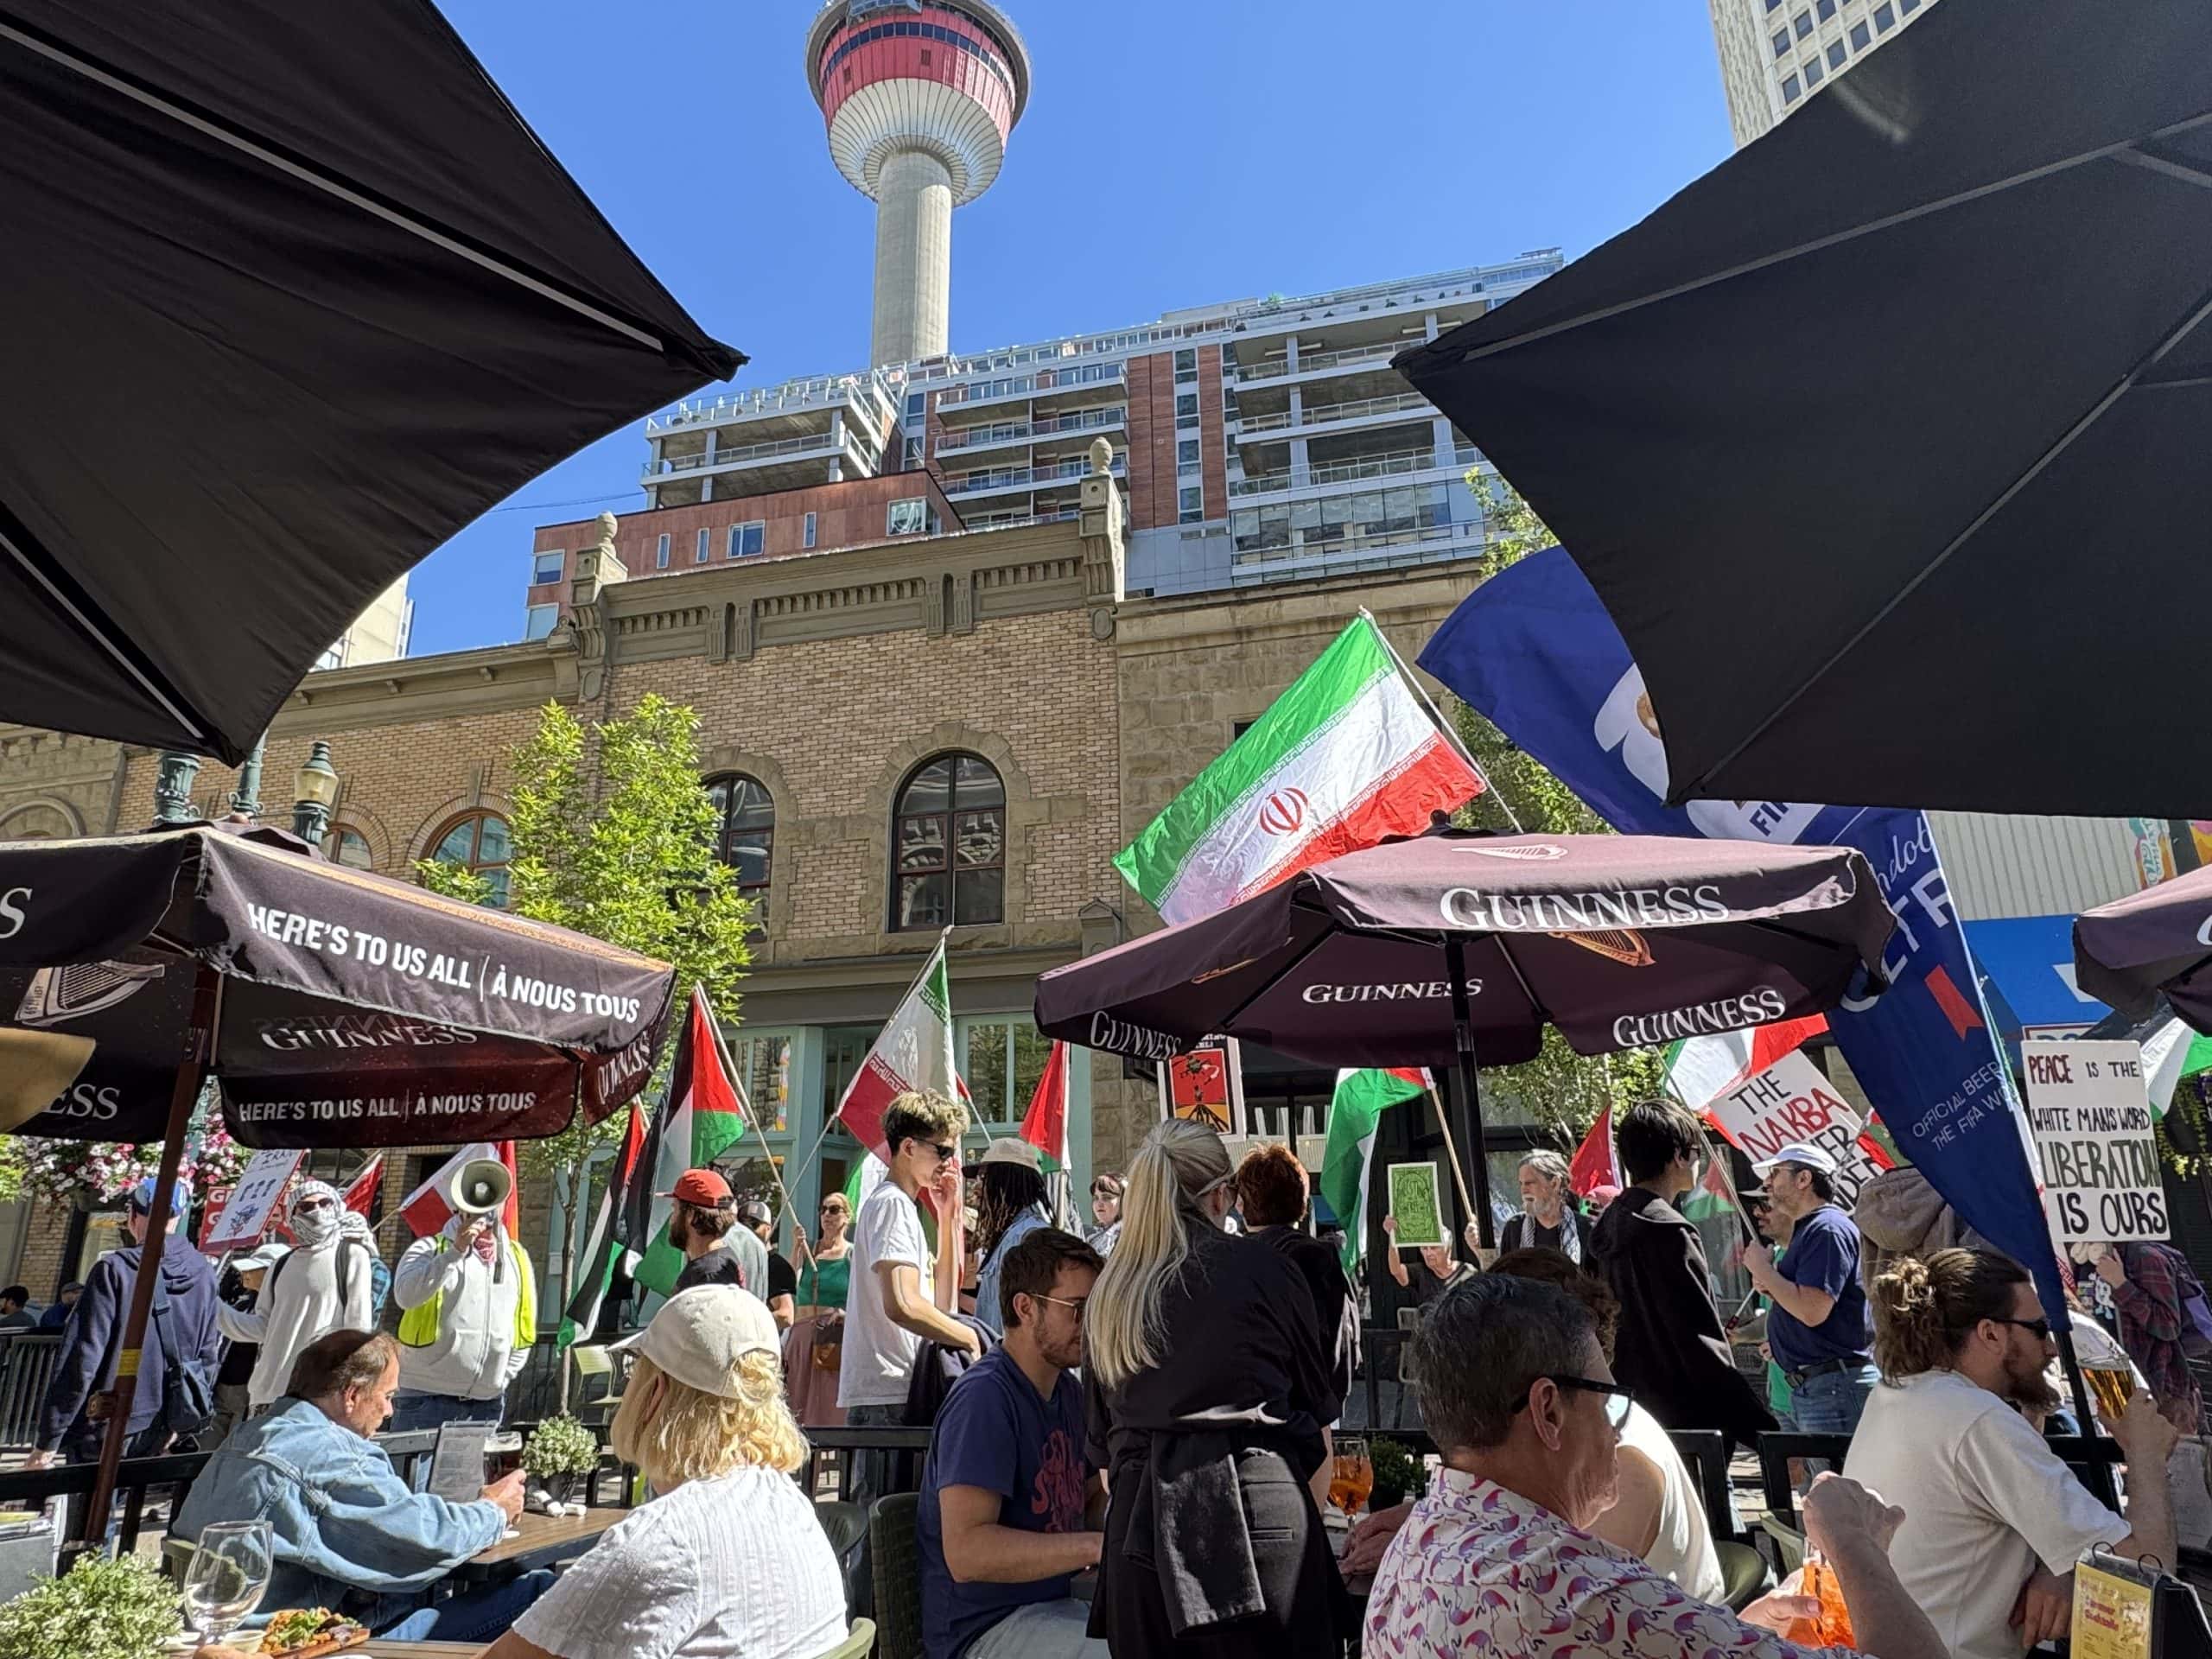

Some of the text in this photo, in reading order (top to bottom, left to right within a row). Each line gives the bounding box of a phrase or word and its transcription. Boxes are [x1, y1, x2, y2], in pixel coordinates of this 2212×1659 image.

[1440, 886, 1729, 931] GUINNESS
[247, 903, 640, 1023] HERE'S TO US ALL À NOUS TOUS
[262, 1026, 477, 1051] GUINNESS
[1090, 1010, 1182, 1058] GUINNESS
[1612, 989, 1786, 1047] GUINNESS
[2027, 1054, 2140, 1084] PEACE IS THE
[239, 1091, 537, 1122] HERE'S TO US ALL À NOUS TOUS
[1728, 1070, 1792, 1115] THE
[1912, 1061, 2003, 1138] OFFICIAL BEER
[1738, 1088, 1849, 1162] NAKBA
[1931, 1124, 1956, 1152] THE
[1957, 1105, 1986, 1135] FIFA
[2031, 1107, 2151, 1133] WHITE MANS WORD
[2037, 1139, 2164, 1190] LIBERATION
[2057, 1191, 2168, 1237] IS OURS
